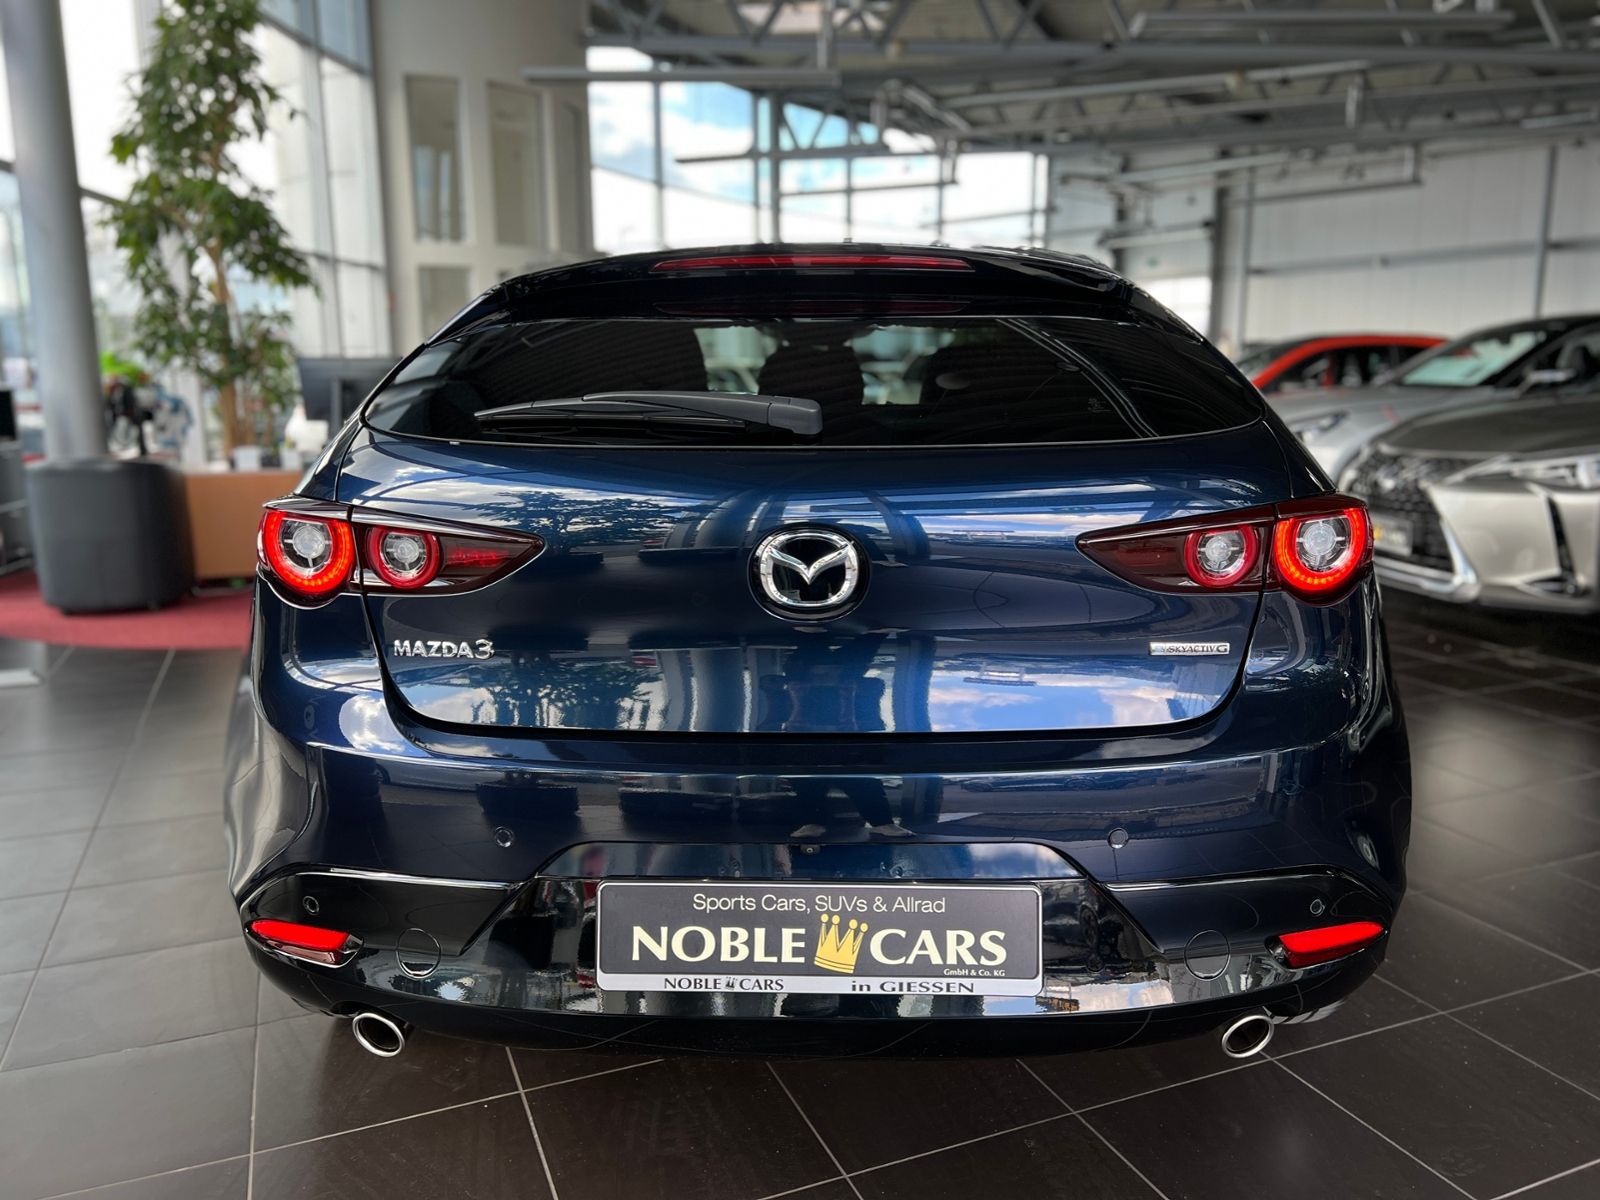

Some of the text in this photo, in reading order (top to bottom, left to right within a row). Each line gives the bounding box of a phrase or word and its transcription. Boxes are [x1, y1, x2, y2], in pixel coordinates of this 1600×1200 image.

[693, 893, 946, 914] Sports Cars, SUVs & Allrad
[631, 925, 1008, 967] NOBLE CARS
[943, 968, 969, 976] GmbH
[978, 969, 992, 977] Co.
[993, 969, 1006, 977] KG
[664, 977, 784, 991] NOBLE CARS
[851, 980, 975, 994] in GIESSEN
